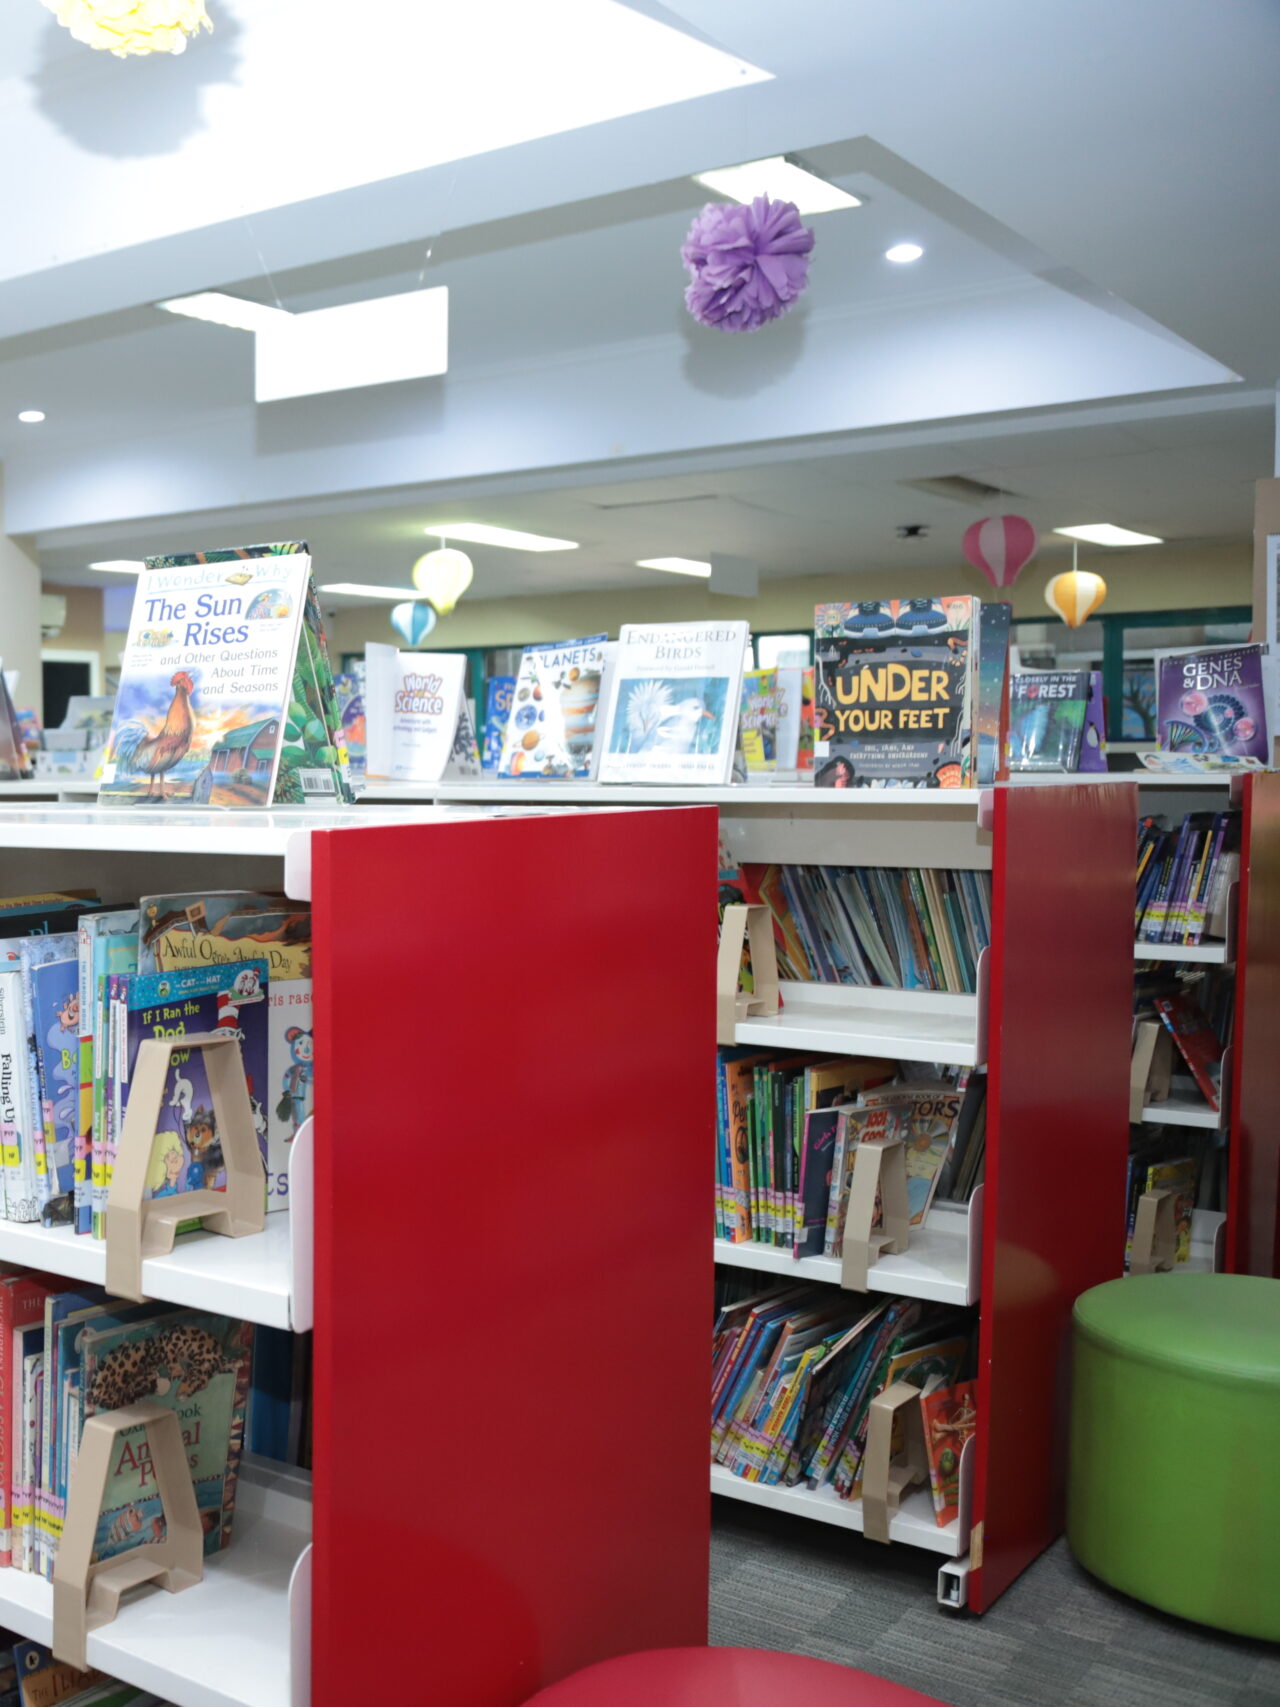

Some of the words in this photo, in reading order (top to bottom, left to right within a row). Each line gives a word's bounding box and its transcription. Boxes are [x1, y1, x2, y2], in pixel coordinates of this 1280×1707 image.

[145, 598, 186, 622] The
[195, 593, 242, 618] Sun
[184, 622, 249, 646] Rises
[161, 654, 181, 666] and
[185, 652, 215, 664] Other
[220, 649, 278, 662] Questions
[655, 646, 702, 659] BIRDS
[211, 667, 244, 679] About
[251, 665, 278, 676] Time
[1183, 657, 1243, 677] GENES
[203, 684, 224, 695] and
[230, 682, 278, 695] Seasons
[404, 673, 443, 694] World
[836, 663, 950, 704] UNDER
[1183, 677, 1195, 688] &
[1196, 671, 1242, 690] DNA
[395, 690, 443, 714] Science
[835, 709, 893, 732] YOUR
[899, 707, 950, 729] FEET
[163, 935, 197, 959] Awful
[271, 950, 293, 974] Day
[181, 978, 197, 989] CAT
[206, 975, 221, 985] HAT
[143, 1012, 152, 1024] If
[156, 1010, 161, 1021] I
[163, 1006, 181, 1019] Ran
[184, 1001, 200, 1014] the
[1, 1052, 13, 1105] Falling
[177, 1403, 201, 1419] ook
[114, 1421, 200, 1477] Anal
